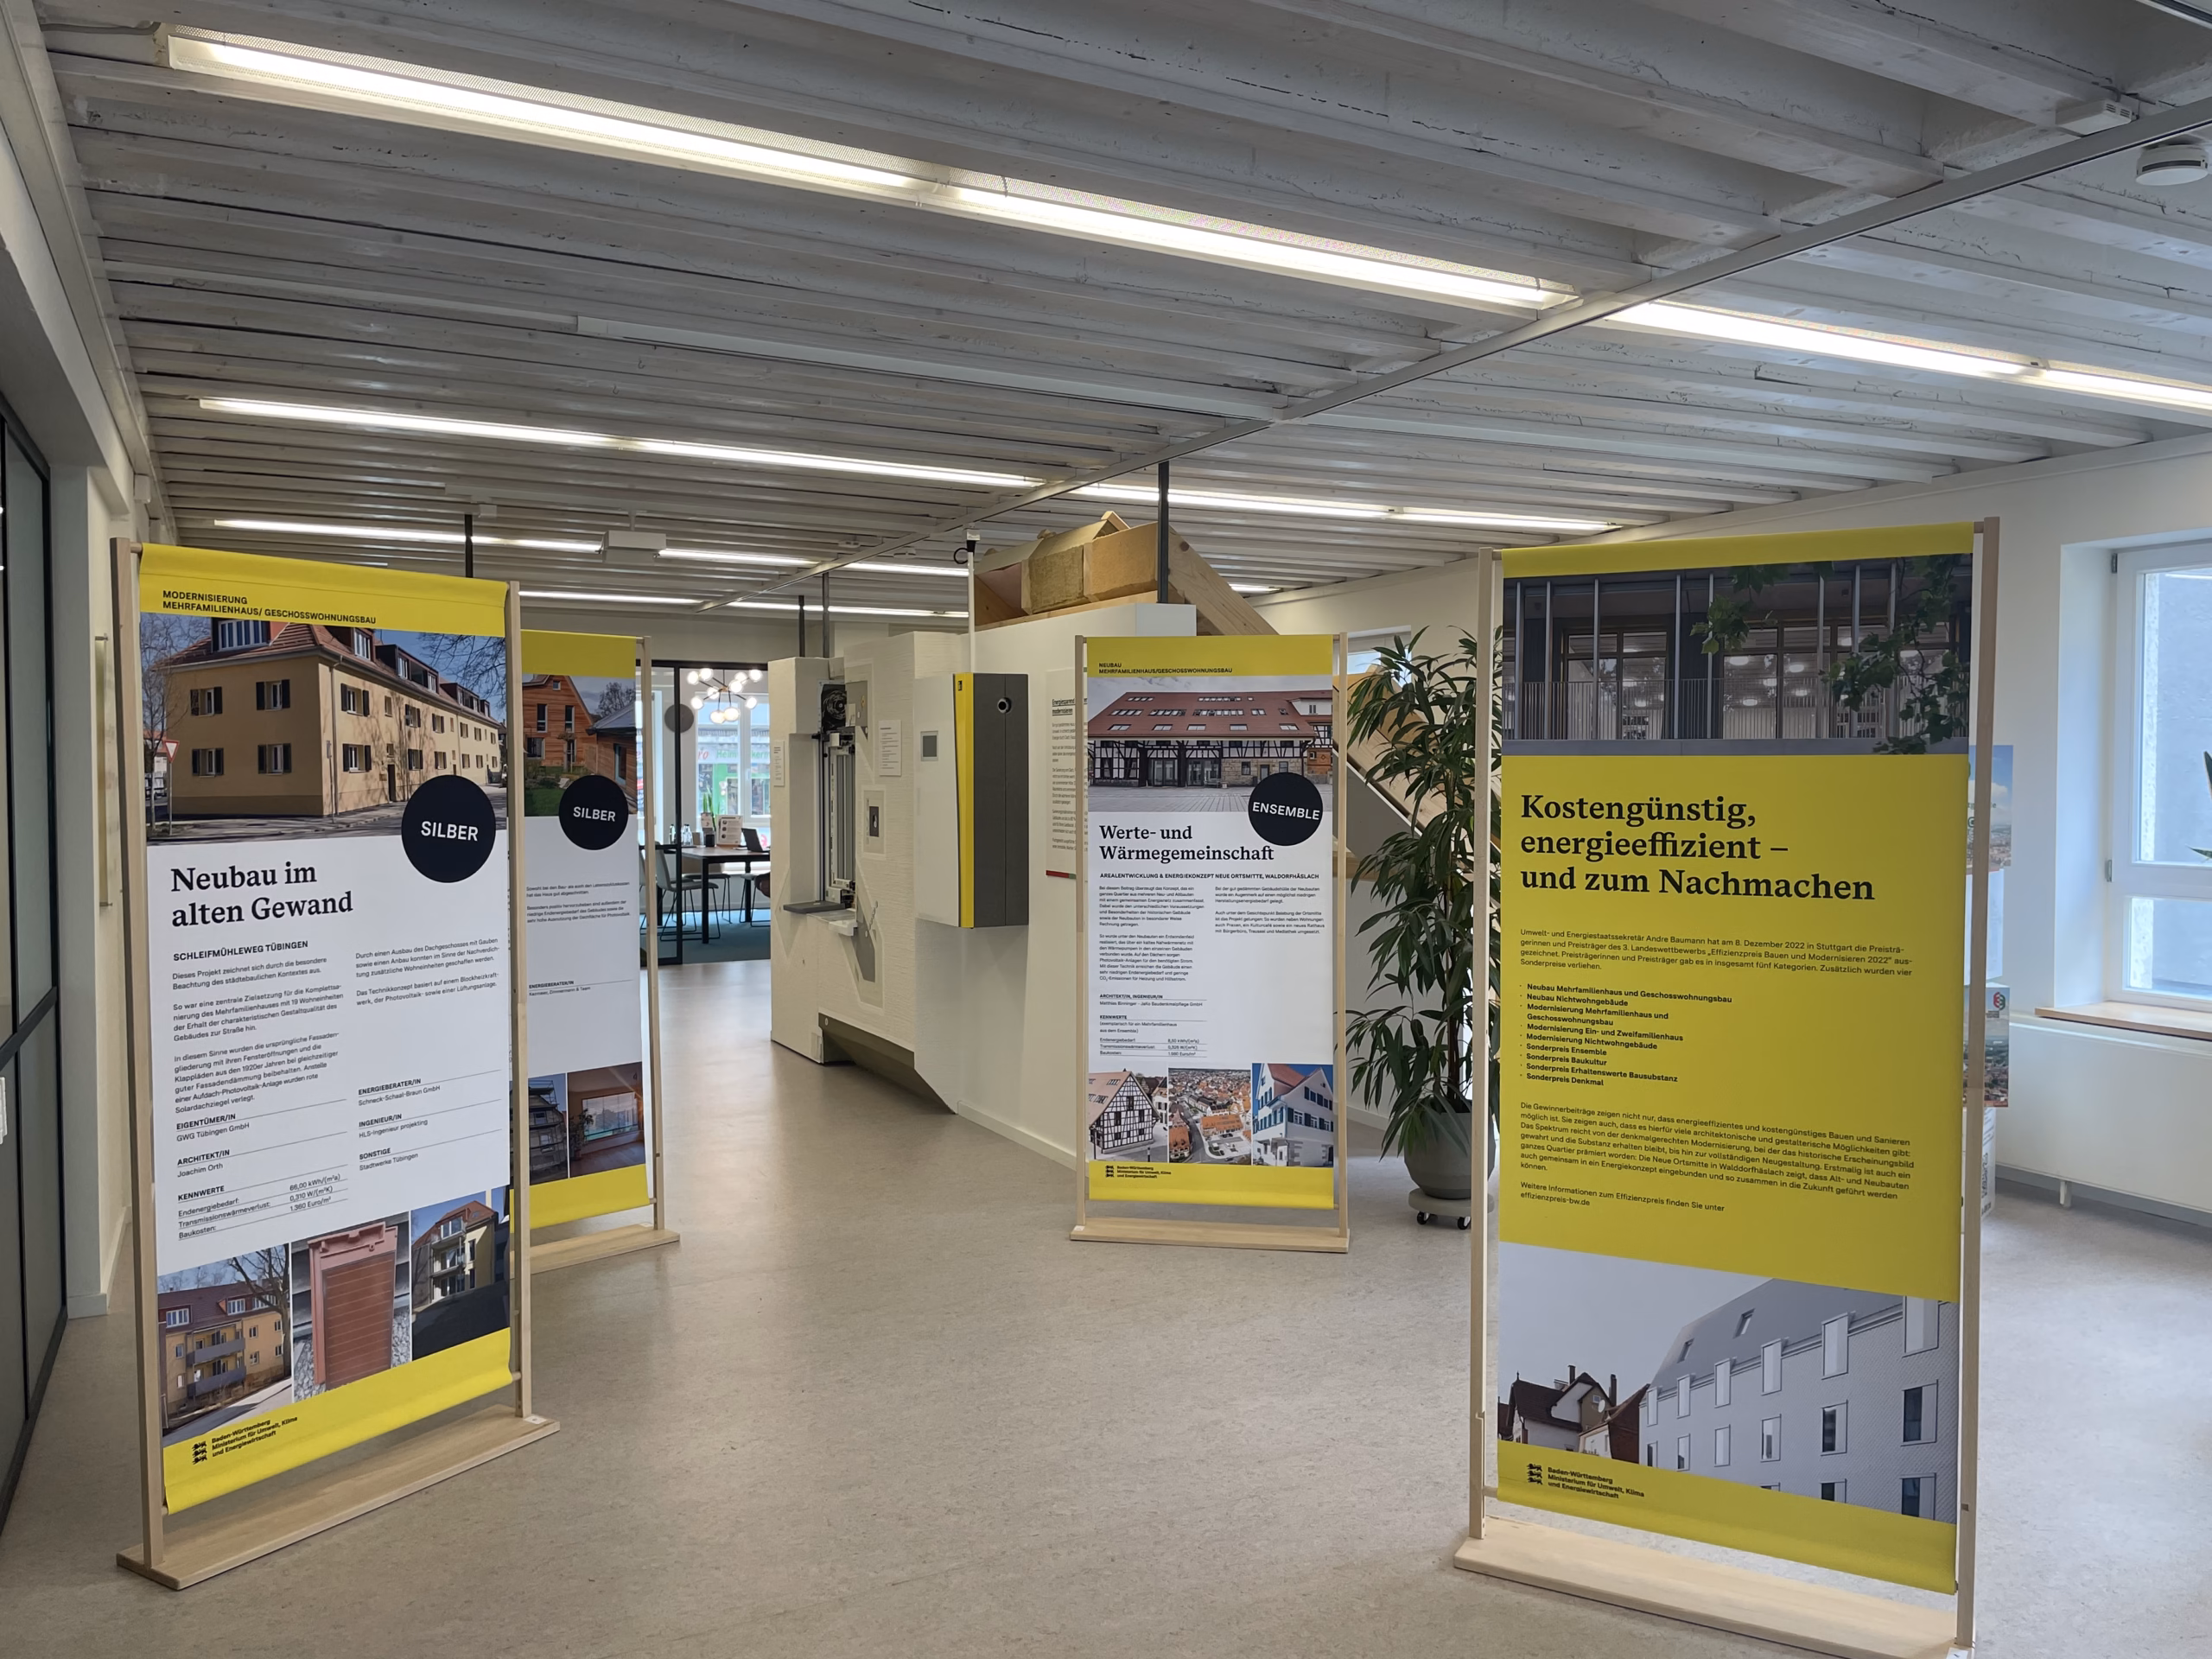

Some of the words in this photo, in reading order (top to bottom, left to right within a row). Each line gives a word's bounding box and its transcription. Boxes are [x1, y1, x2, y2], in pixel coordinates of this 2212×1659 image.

[163, 591, 247, 605] MODERNISIERUNG
[163, 601, 262, 617] MEHRFAMILIENHAUS/
[264, 608, 376, 625] GESCHOSSWOHNUNGSBAU
[573, 805, 616, 823] SILBER
[1253, 802, 1320, 821] ENSEMBLE
[1522, 794, 1755, 828] Kostengünstig,
[421, 821, 478, 842] SILBER
[1101, 825, 1156, 840] Werte-
[1160, 825, 1192, 840] und
[1521, 830, 1761, 860] energieeffizient
[1101, 846, 1274, 863] Wärmegemeinschaft
[172, 864, 276, 893] Neubau
[285, 860, 315, 885] im
[1522, 864, 1575, 890] und
[1585, 871, 1649, 893] zum
[1659, 868, 1874, 900] Nachmachen
[172, 900, 244, 927] alten
[251, 888, 352, 921] Gewand
[1567, 931, 1644, 941] Energiestaatssekretär
[1744, 939, 1783, 948] Dezember
[1816, 943, 1853, 951] Stuttgart
[174, 945, 264, 962] SCHLEIFMÜHLEWEG
[265, 941, 308, 952] TÜBINGEN
[1568, 942, 1607, 950] Preisträger
[1631, 945, 1707, 955] Landeswettbewerbs
[1707, 949, 1763, 958] „Effizienzpreis
[1808, 953, 1866, 963] Modernisieren
[197, 968, 221, 977] Projekt
[223, 965, 250, 975] zeichnet
[265, 961, 283, 969] durch
[296, 957, 327, 966] besondere
[173, 981, 210, 990] Beachtung
[225, 973, 276, 984] städtebaulichen
[277, 969, 308, 978] Kontextes
[1556, 995, 1628, 1006] Nichtwohngebäude
[1557, 985, 1623, 995] Mehrfamilienhaus
[1640, 990, 1732, 1002] Geschosswohnungsbau
[1528, 1003, 1584, 1014] Modernisierung
[1586, 1007, 1653, 1018] Mehrfamilienhaus
[1527, 1014, 1613, 1026] Geschosswohnungsbau
[174, 1032, 209, 1041] Gebäudes
[222, 1027, 244, 1035] Straße
[1527, 1033, 1583, 1045] Modernisierung
[1585, 1038, 1657, 1049] Nichtwohngebäude
[1528, 1023, 1584, 1035] Modernisierung
[1617, 1030, 1683, 1041] Zweifamilienhaus
[1527, 1043, 1570, 1052] Sonderpreis
[1571, 1046, 1607, 1056] Ensemble
[1527, 1053, 1570, 1063] Sonderpreis
[1571, 1057, 1607, 1065] Baukultur
[1527, 1063, 1569, 1073] Sonderpreis
[1571, 1066, 1627, 1077] Erhaltenswerte
[1629, 1071, 1678, 1082] Bausubstanz
[1527, 1072, 1570, 1083] Sonderpreis
[1571, 1077, 1604, 1085] Denkmal
[359, 1078, 421, 1096] ENERGIEBERATER/IN
[176, 1114, 236, 1130] EIGENTÜMER/IN
[359, 1114, 402, 1128] INGENIEUR/IN
[176, 1132, 195, 1142] GWG
[197, 1128, 228, 1138] Tübingen
[229, 1122, 250, 1132] GmbH
[177, 1149, 230, 1166] ARCHITEKT/IN
[359, 1147, 391, 1160] SONSTIGE
[359, 1158, 392, 1171] Stadtwerke
[392, 1153, 418, 1163] Tübingen
[177, 1167, 207, 1178] Joachim
[207, 1163, 223, 1172] Orth
[178, 1185, 224, 1201] KENNWERTE
[1521, 1182, 1547, 1191] Weitere
[1548, 1185, 1598, 1197] Informationen
[1616, 1192, 1665, 1205] Effizienzpreis
[1666, 1198, 1689, 1207] finden
[1521, 1192, 1590, 1206] effizienzpreis-bw.de
[178, 1198, 240, 1217] Endenergiebedarf:
[179, 1226, 217, 1239] Baukosten:
[212, 1420, 270, 1444] Baden-Württemberg
[212, 1434, 247, 1451] Ministerium
[247, 1430, 256, 1439] für
[257, 1421, 281, 1435] Umwelt,
[282, 1416, 297, 1427] Klima
[213, 1447, 224, 1458] und
[226, 1429, 276, 1453] Energiewirtschaft
[1548, 1466, 1613, 1484] Baden-Württemberg
[1548, 1473, 1586, 1486] Ministerium
[1598, 1483, 1624, 1494] Umwelt,
[1625, 1488, 1644, 1497] Klima
[1562, 1483, 1619, 1498] Energiewirtschaft
